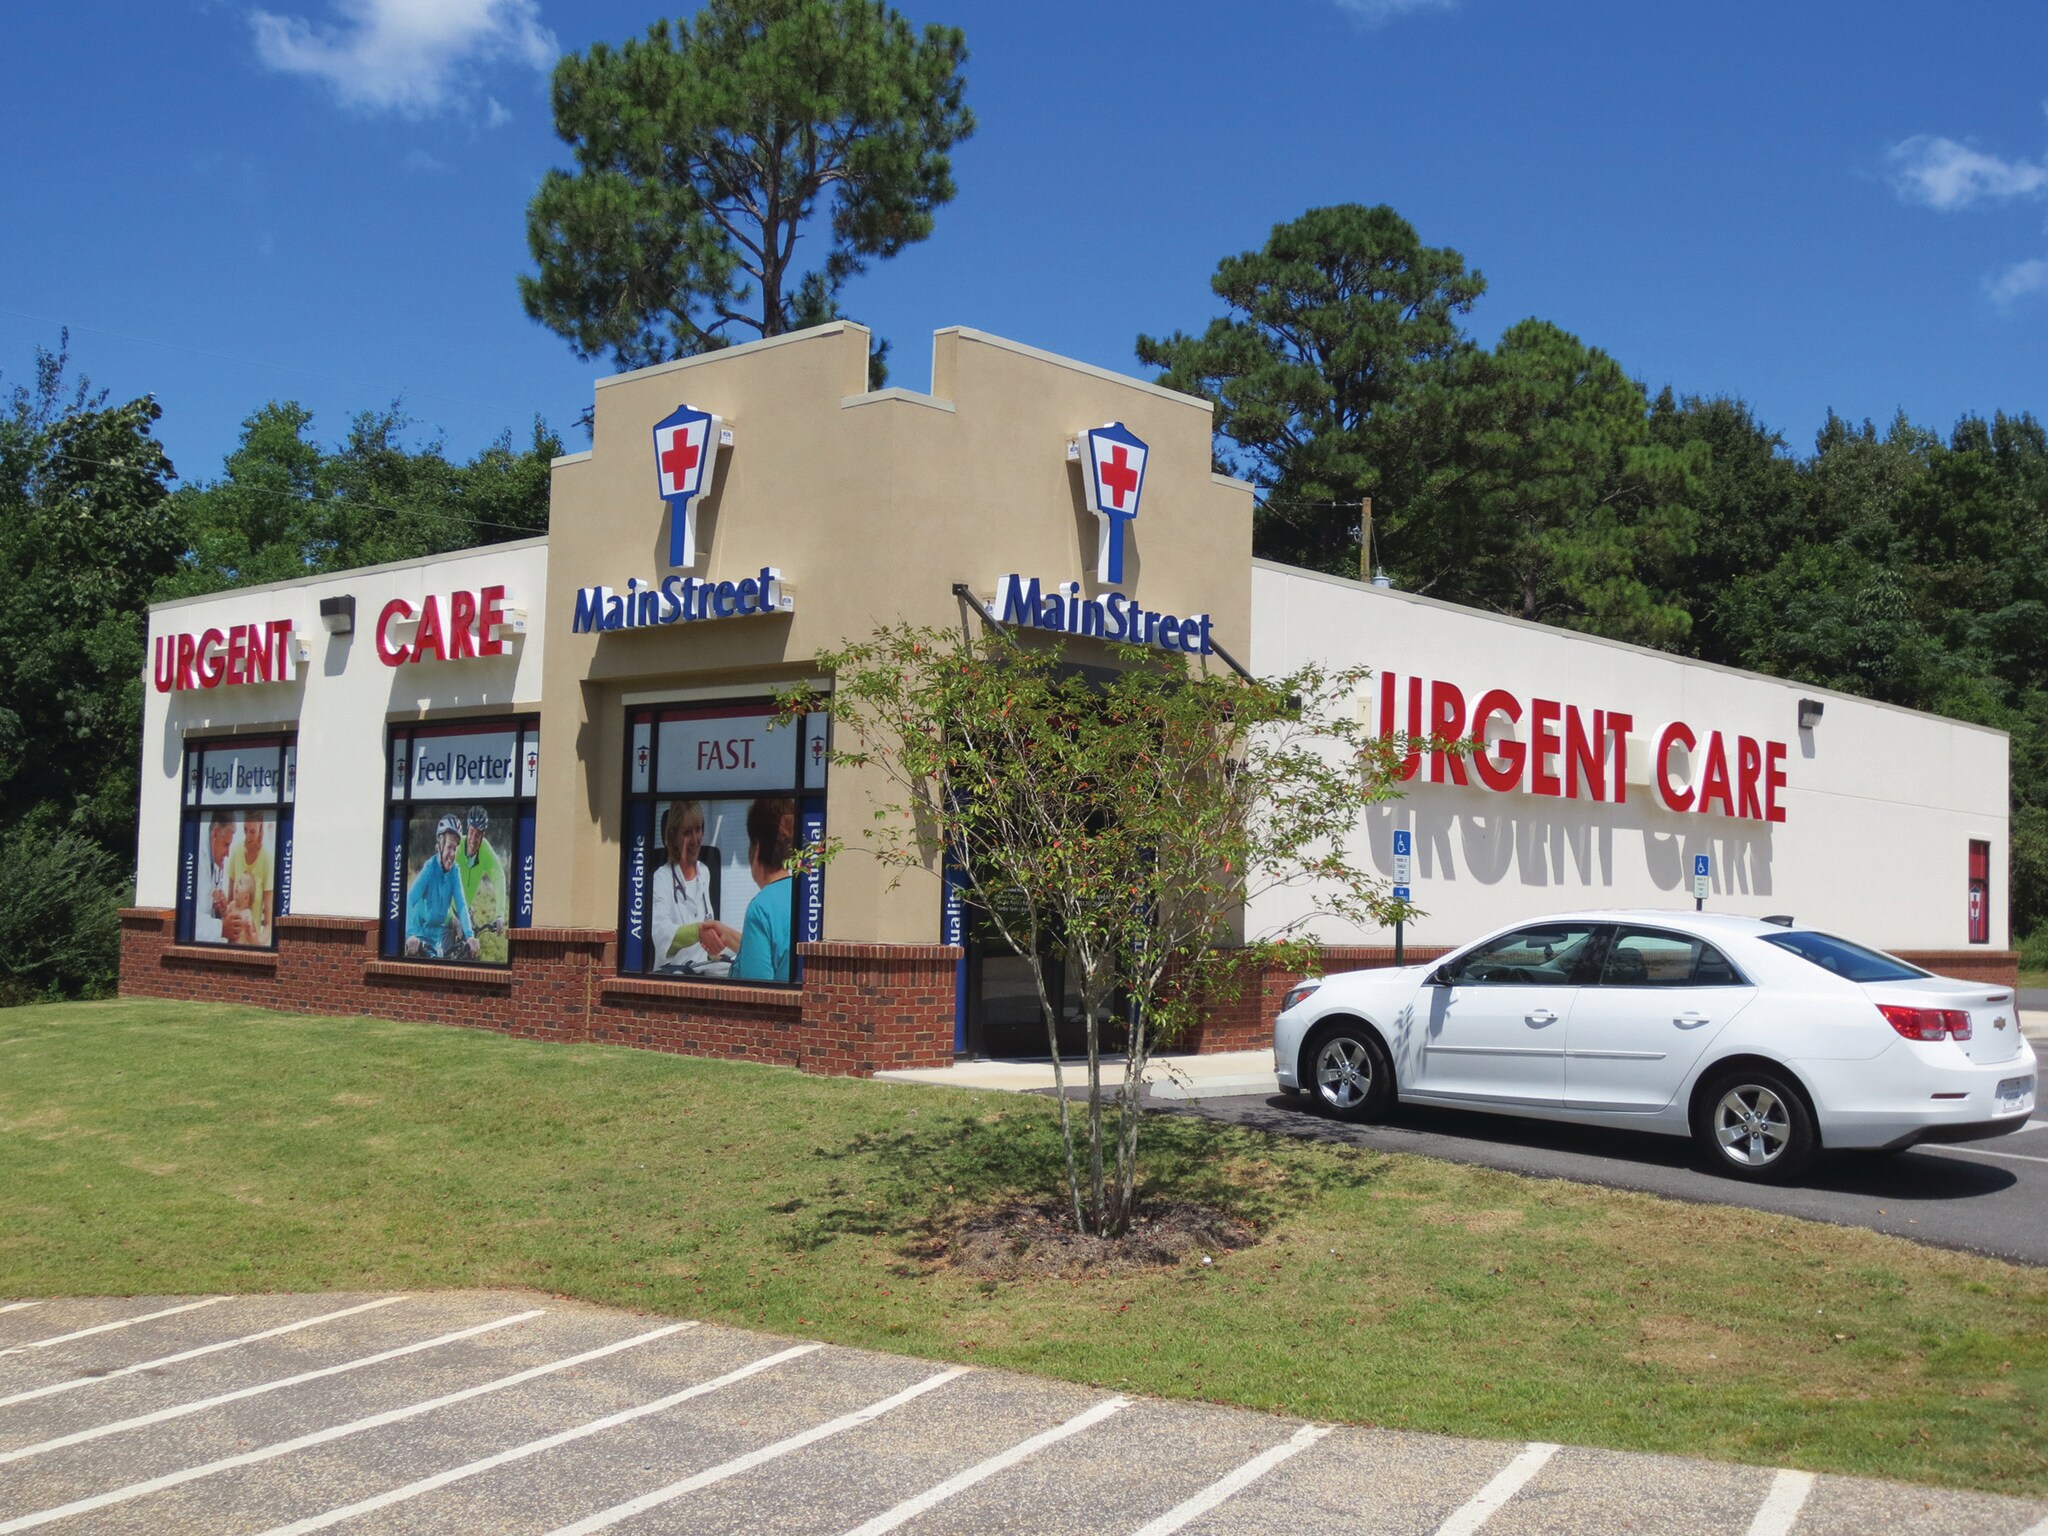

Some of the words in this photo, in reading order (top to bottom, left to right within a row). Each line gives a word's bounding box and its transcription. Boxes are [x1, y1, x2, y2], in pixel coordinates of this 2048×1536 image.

[572, 566, 775, 634] MainStreet
[1003, 573, 1214, 655] MainStreet
[154, 618, 293, 693] URGENT
[376, 585, 504, 667] CARE
[205, 764, 232, 789] Heal
[418, 752, 451, 783] Feel
[455, 752, 513, 781] Better.
[697, 738, 757, 770] FAST.
[1376, 671, 1633, 803] URGENT
[1657, 721, 1787, 823] CARE
[280, 840, 293, 917] Pediatrics
[390, 844, 402, 920] Wellness
[520, 855, 533, 915] Sports
[630, 835, 645, 940] Affordable
[807, 821, 822, 943] ccupatial
[947, 888, 961, 948] ualit
